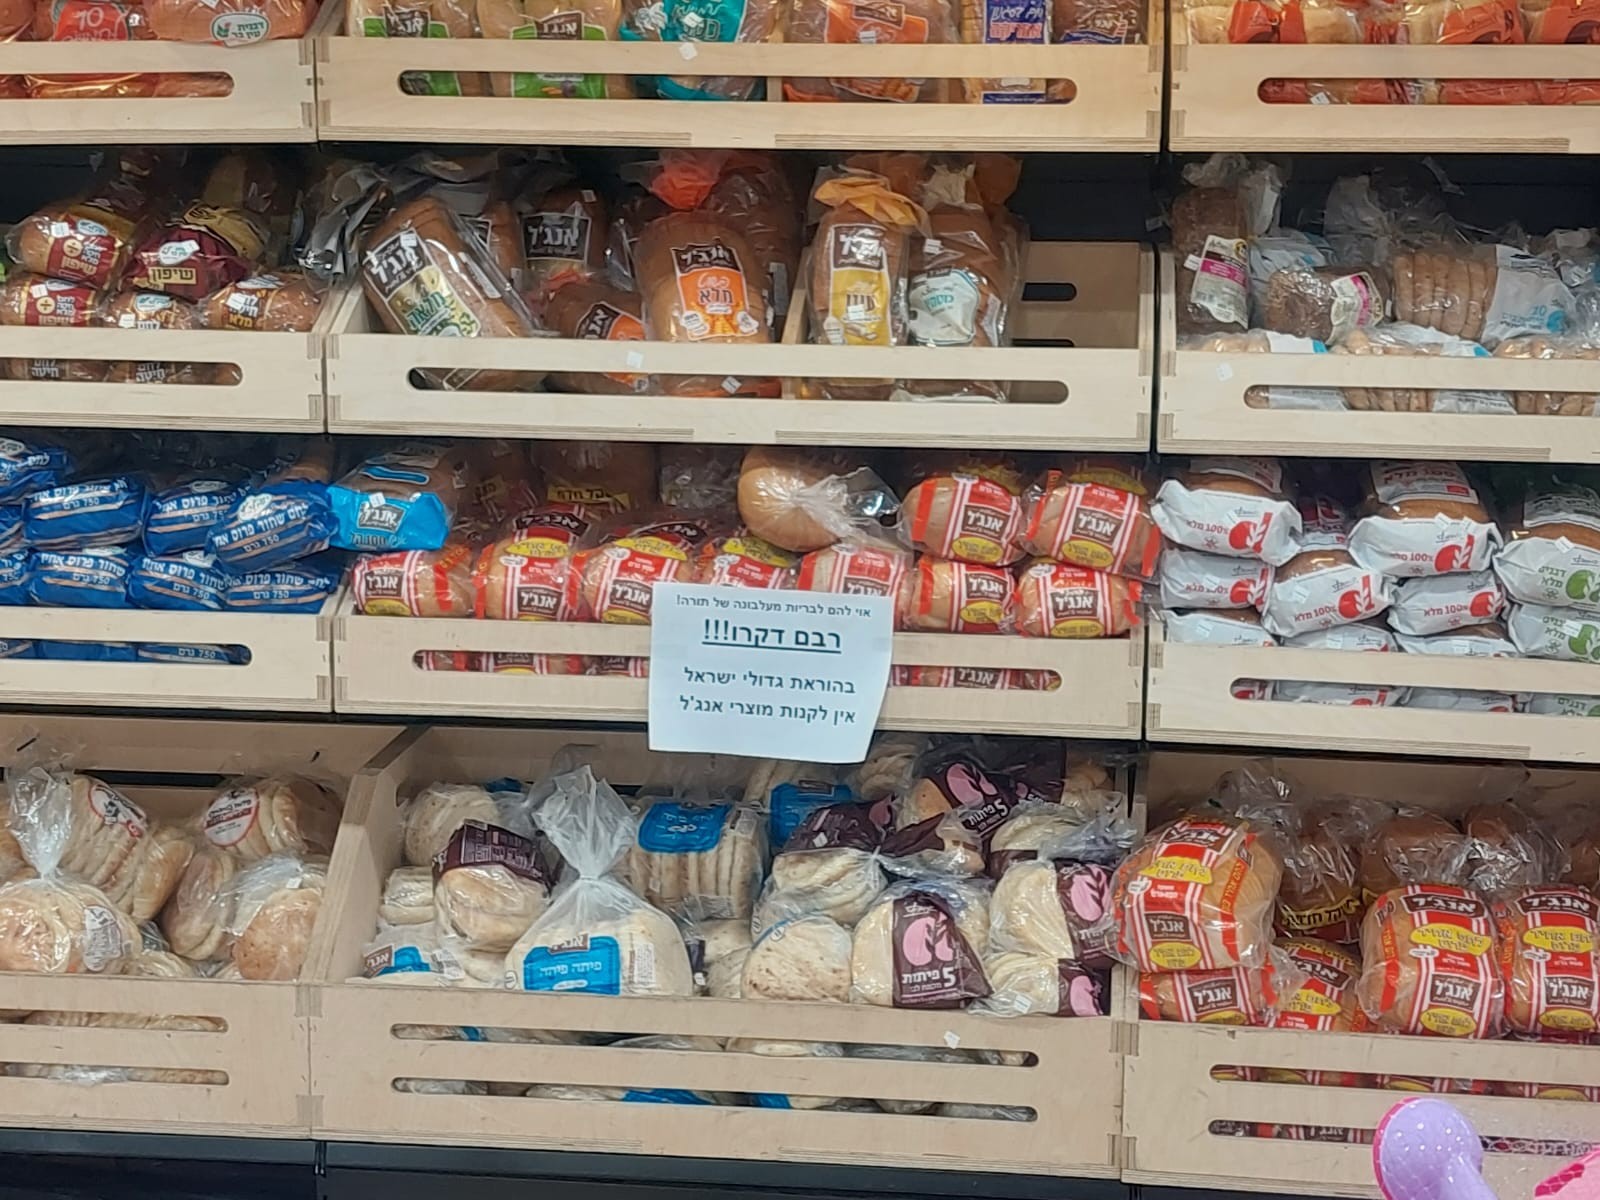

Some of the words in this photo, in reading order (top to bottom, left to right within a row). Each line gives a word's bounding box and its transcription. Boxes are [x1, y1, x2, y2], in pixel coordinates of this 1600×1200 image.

[528, 224, 579, 248] אנג'ל
[681, 245, 731, 264] אנג'ל
[151, 267, 195, 282] שיפון
[181, 495, 208, 508] פרוס
[258, 513, 286, 532] שחור
[361, 503, 397, 525] אנג'ל
[967, 510, 1004, 532] אנג'ל
[232, 523, 255, 541] פרוס
[1078, 513, 1117, 536] אנג'ל
[66, 555, 94, 568] פרוס
[98, 558, 126, 577] שחור
[168, 565, 195, 581] פרוס
[245, 574, 271, 586] פרוס
[277, 574, 304, 586] שחור
[366, 575, 398, 589] אנג'ל
[272, 590, 290, 600] 750
[520, 591, 557, 610] אנג'ל
[616, 584, 650, 605] אנג'ל
[676, 594, 710, 608] תורה!
[712, 596, 730, 608] של
[1055, 595, 1094, 611] אנג'ל
[733, 598, 782, 613] מעלבונה
[785, 601, 824, 615] לבריות
[827, 604, 851, 617] להם
[855, 607, 872, 618] אוי
[703, 617, 786, 648] דקרו!!!
[795, 631, 842, 648] רבם
[684, 666, 736, 686] ישראל
[744, 670, 784, 689] גדולי
[789, 675, 856, 694] בהוראת
[958, 667, 995, 685] אנג'ל
[680, 695, 723, 713] אנג'ל
[729, 701, 773, 717] מוצרי
[779, 705, 827, 725] לקנות
[833, 710, 856, 726] אין
[994, 798, 1009, 817] 5
[1412, 896, 1477, 913] אנג'ל
[1526, 895, 1589, 911] אנג'ל
[1149, 918, 1185, 933] אנג'ל
[902, 969, 941, 985] פיתות
[943, 966, 957, 988] 5
[1193, 986, 1233, 1006] אנג'ל
[1434, 979, 1474, 1001] אנג'ל
[1549, 979, 1589, 1000] אנג'ל
